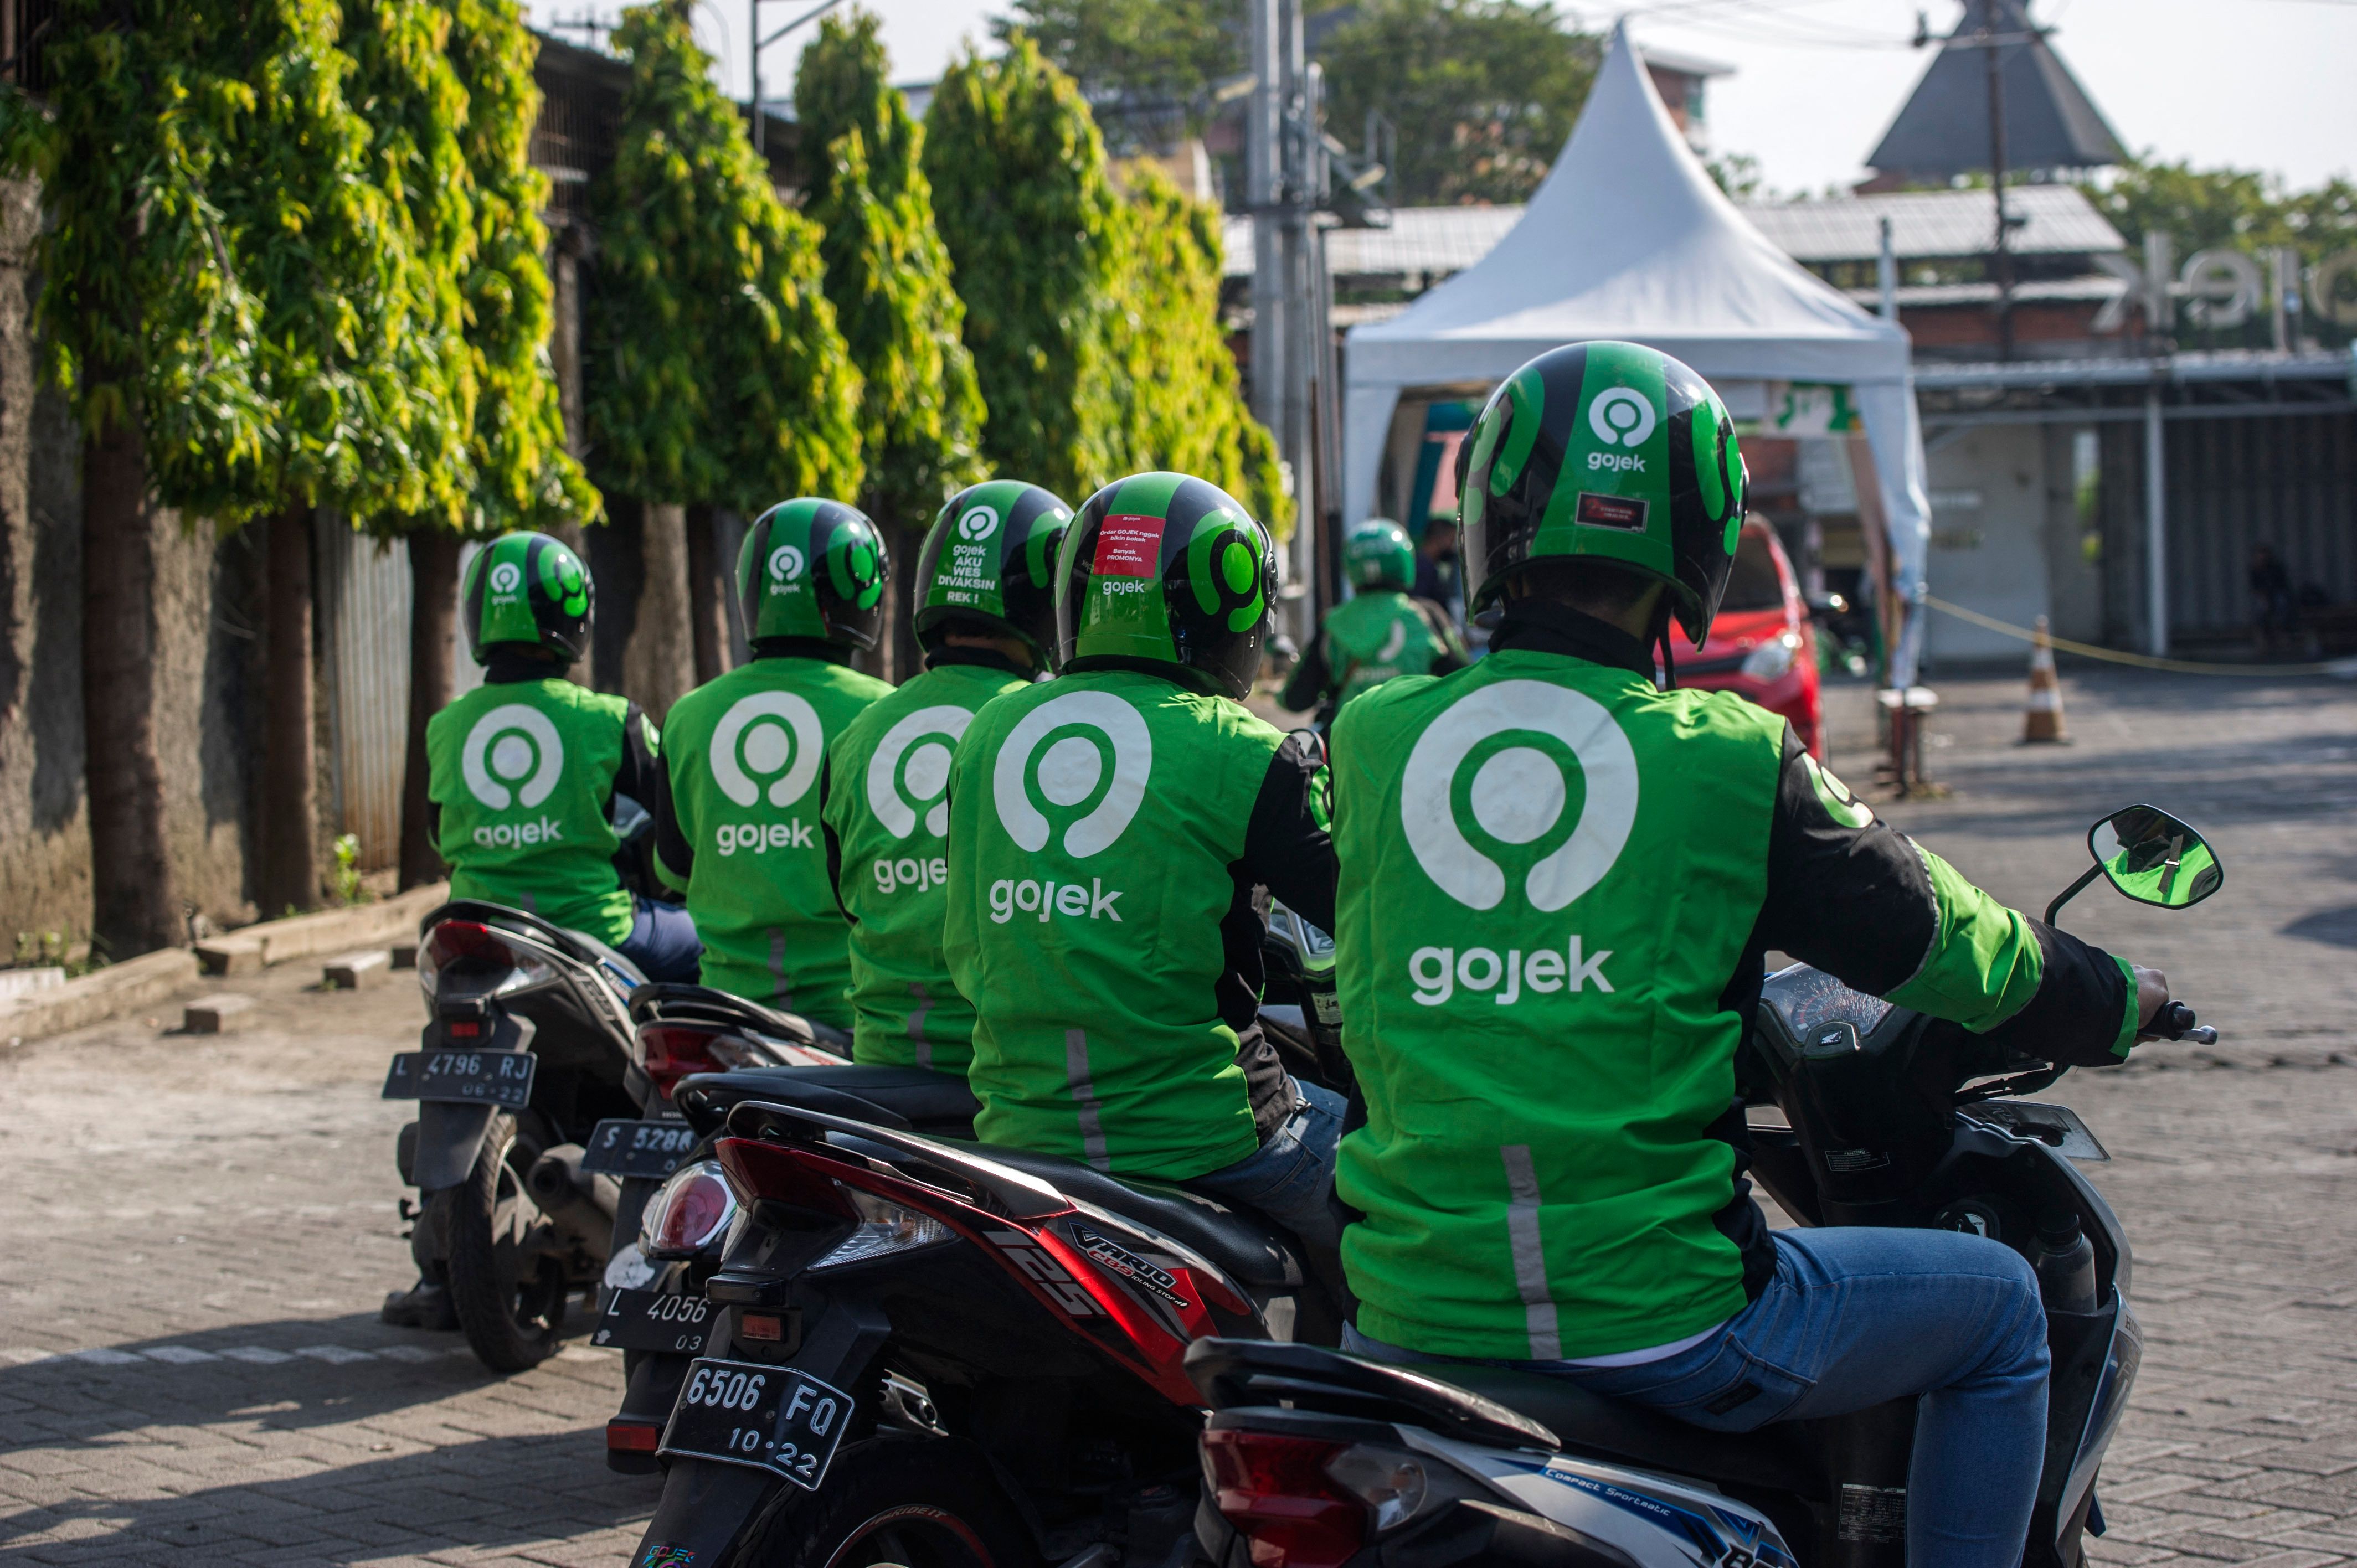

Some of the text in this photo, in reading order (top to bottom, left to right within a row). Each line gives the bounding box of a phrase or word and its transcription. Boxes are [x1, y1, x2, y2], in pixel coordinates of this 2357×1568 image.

[1587, 452, 1646, 473] gojek
[953, 544, 987, 557] gojek
[955, 556, 982, 568] AKU
[938, 575, 996, 591] DIVAKSIN
[953, 566, 981, 577] WES
[946, 591, 971, 603] REK
[1103, 580, 1145, 595] gojek
[473, 814, 564, 850] gojek
[716, 817, 815, 857] gojek
[873, 858, 948, 894] goje
[989, 877, 1124, 924] gojek
[1409, 935, 1615, 1005] gojek
[395, 1054, 529, 1080] L 4796 RJ
[662, 1111, 683, 1119] HON
[603, 1126, 621, 1149] S
[665, 1159, 677, 1173] 0
[1069, 1221, 1177, 1289] VARIO
[1088, 1250, 1134, 1275] CBS
[982, 1226, 1107, 1316] 125
[1131, 1275, 1176, 1301] IDLING STOP
[608, 1288, 711, 1323] L 4056
[676, 1334, 702, 1350] 03
[687, 1368, 765, 1410] 6506
[1545, 1468, 1671, 1517] Compact Sportmatic
